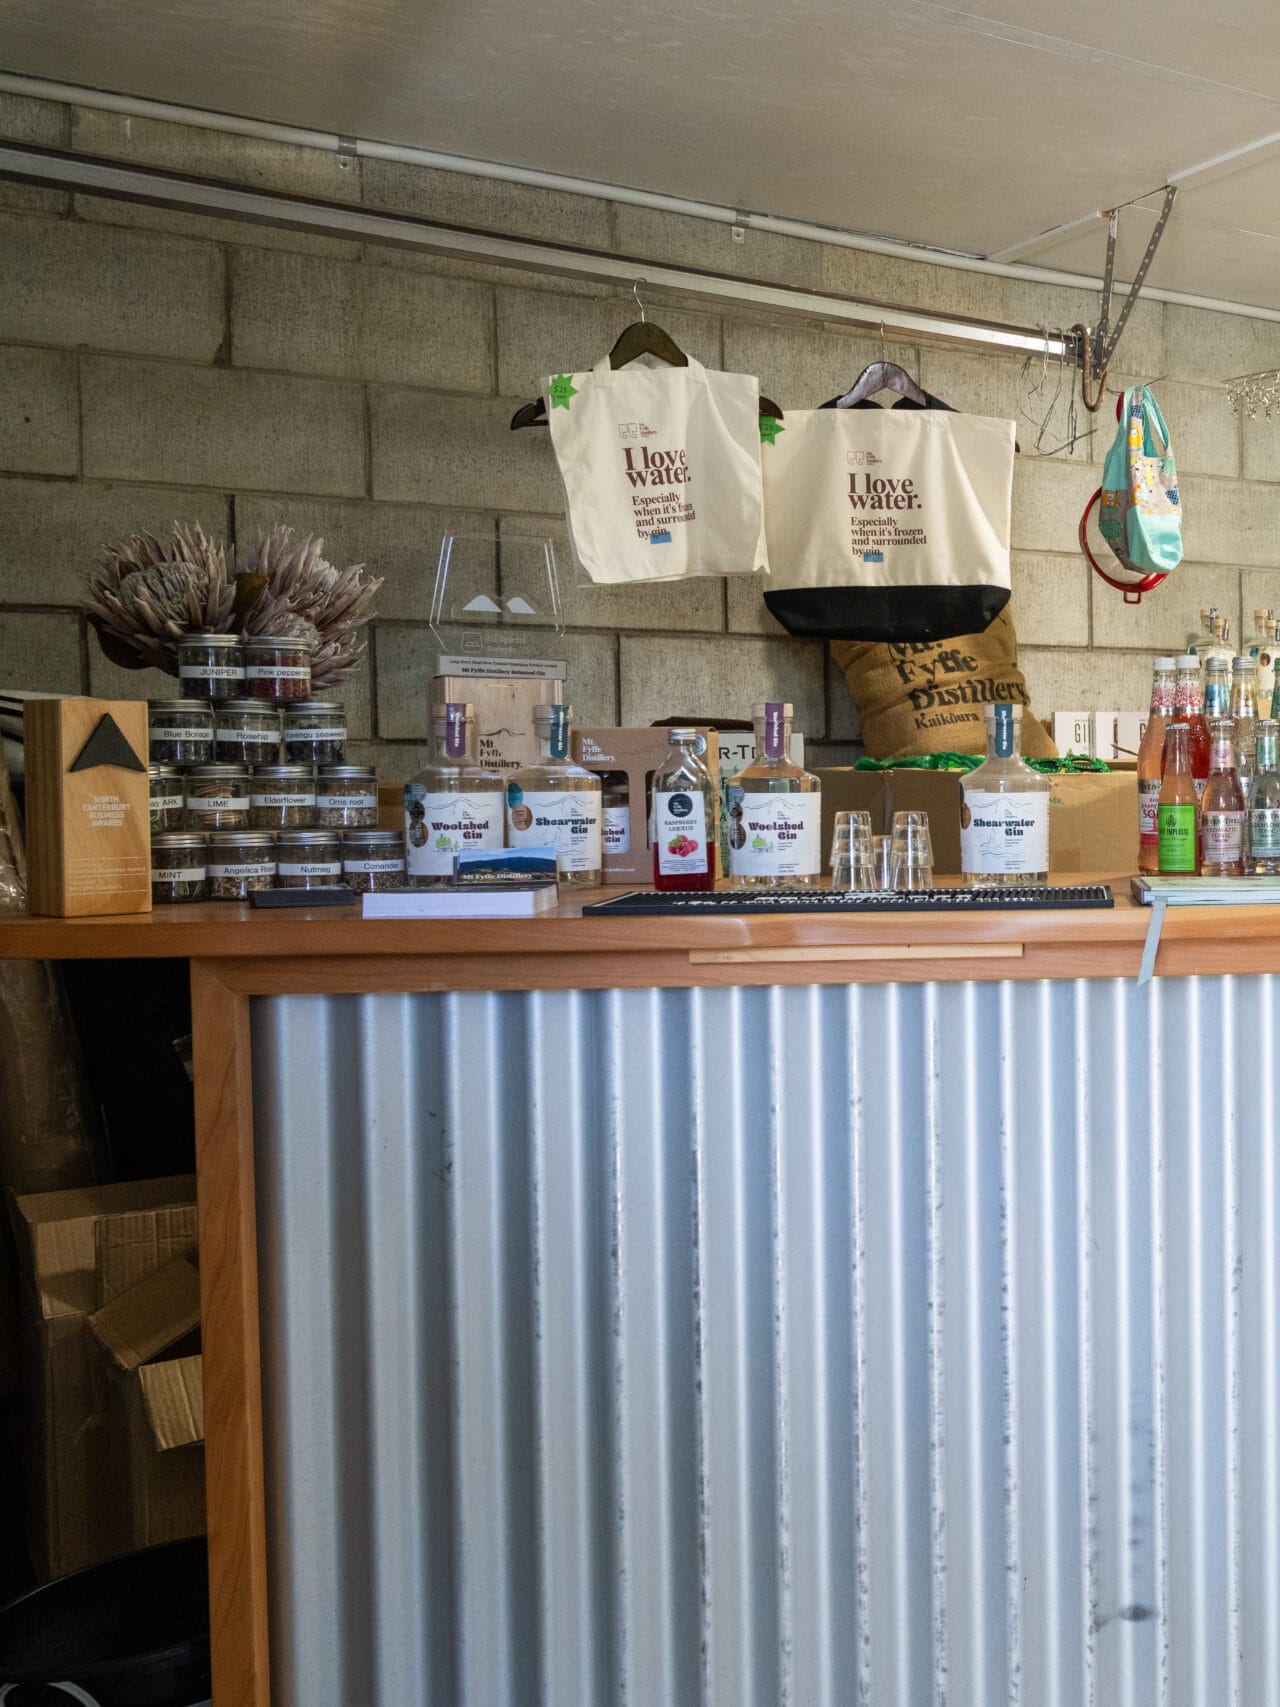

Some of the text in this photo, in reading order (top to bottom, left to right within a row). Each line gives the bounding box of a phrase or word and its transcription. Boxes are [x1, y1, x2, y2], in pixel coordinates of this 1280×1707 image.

[622, 446, 686, 470] I love
[625, 464, 692, 488] water.
[848, 472, 914, 494] I love
[632, 492, 680, 508] Especially
[848, 490, 922, 510] water.
[634, 507, 661, 517] when
[662, 504, 676, 514] it's
[636, 516, 654, 527] and
[850, 516, 898, 528] Especially
[637, 528, 650, 540] by
[850, 527, 924, 537] when it's frozen
[852, 536, 928, 546] and surrounded
[852, 546, 864, 558] by
[896, 648, 979, 686] Fyffe
[236, 732, 269, 740] Rosehip
[94, 795, 120, 804] NORTH
[208, 800, 230, 808] LIME
[82, 803, 132, 812] CANTERBURY
[88, 812, 126, 820] BUSINESS
[535, 816, 596, 826] Shearwater
[92, 819, 122, 827] AWARDS
[431, 820, 490, 831] Woolshed
[748, 821, 804, 831] Woolshed
[973, 818, 1035, 828] Shearwater
[462, 830, 482, 840] Gin
[570, 826, 588, 834] Gin
[778, 830, 798, 840] Gin
[1004, 828, 1024, 836] Gin
[224, 866, 259, 875] Angelica
[300, 866, 331, 874] Nutmeg
